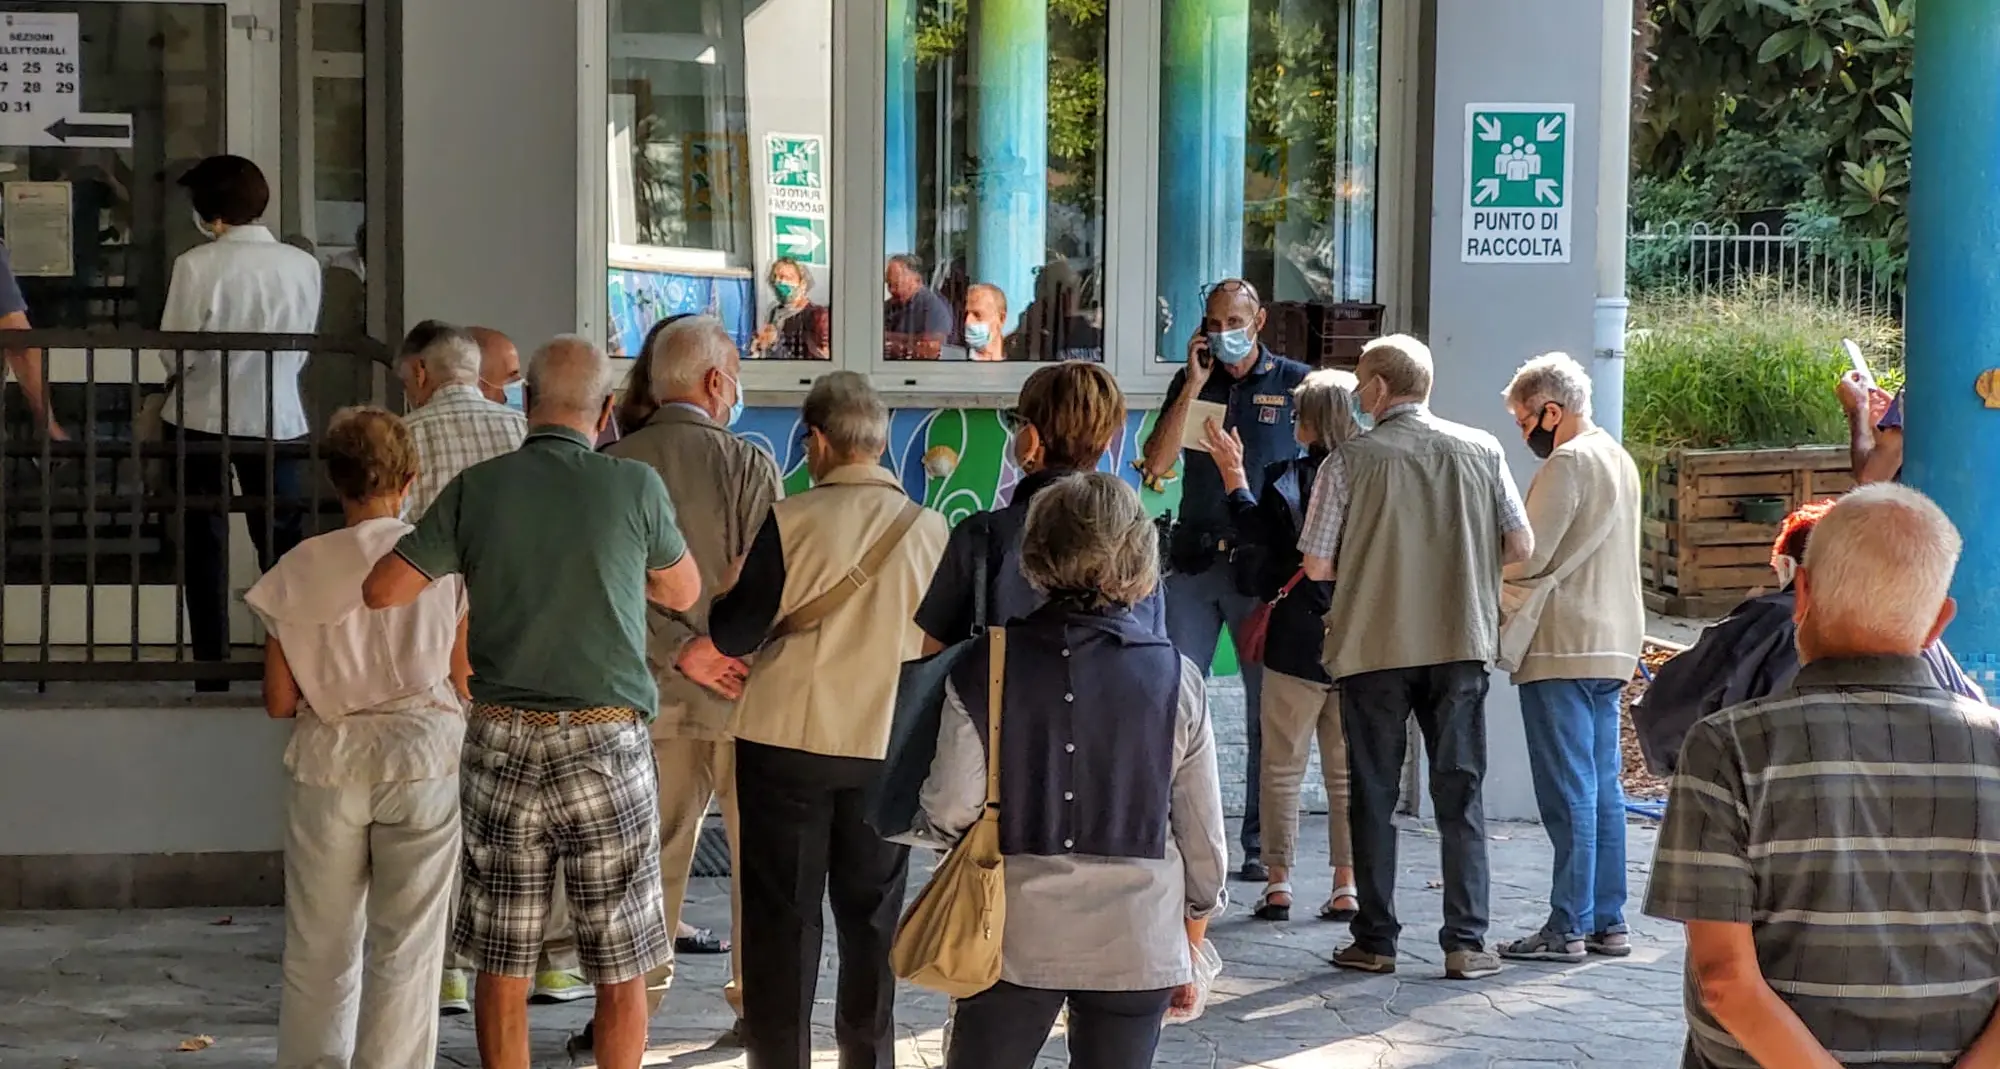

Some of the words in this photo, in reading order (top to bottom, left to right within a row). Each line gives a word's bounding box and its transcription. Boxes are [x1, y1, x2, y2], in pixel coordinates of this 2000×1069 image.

[9, 32, 54, 42] SEZIONI
[22, 61, 41, 73] 25
[55, 62, 75, 74] 26
[23, 81, 41, 93] 28
[55, 82, 75, 94] 29
[14, 100, 31, 112] 31
[1473, 212, 1535, 231] PUNTO
[1541, 212, 1558, 231] DI
[1467, 237, 1563, 256] RACCOLTA
